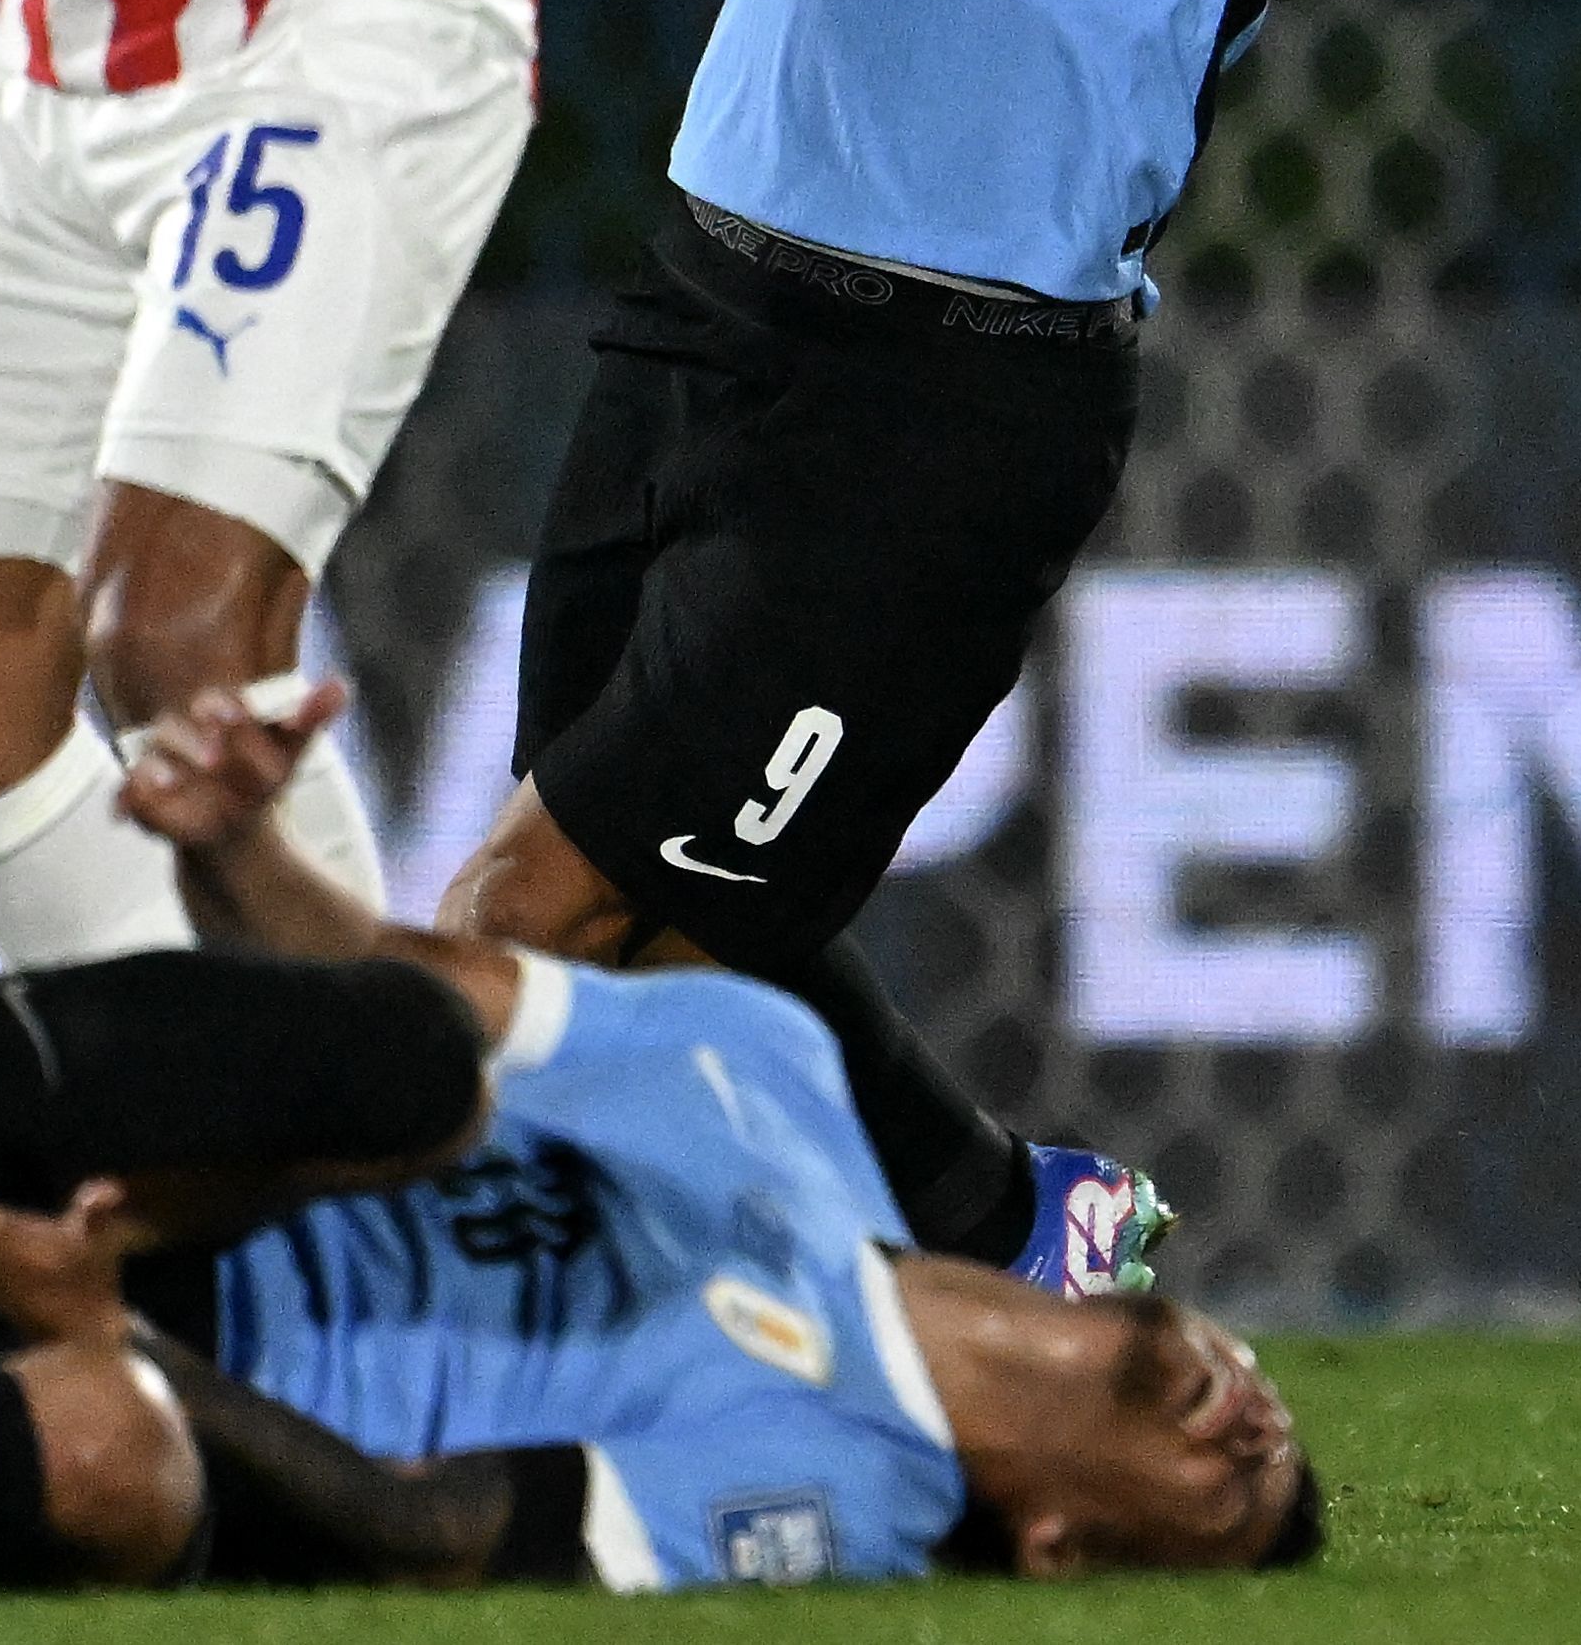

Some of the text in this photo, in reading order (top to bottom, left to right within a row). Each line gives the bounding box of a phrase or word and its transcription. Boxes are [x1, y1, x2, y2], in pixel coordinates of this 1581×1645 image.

[173, 127, 319, 290] 15
[766, 242, 894, 305] PRO
[942, 295, 1087, 339] NIKE
[734, 705, 844, 845] 9
